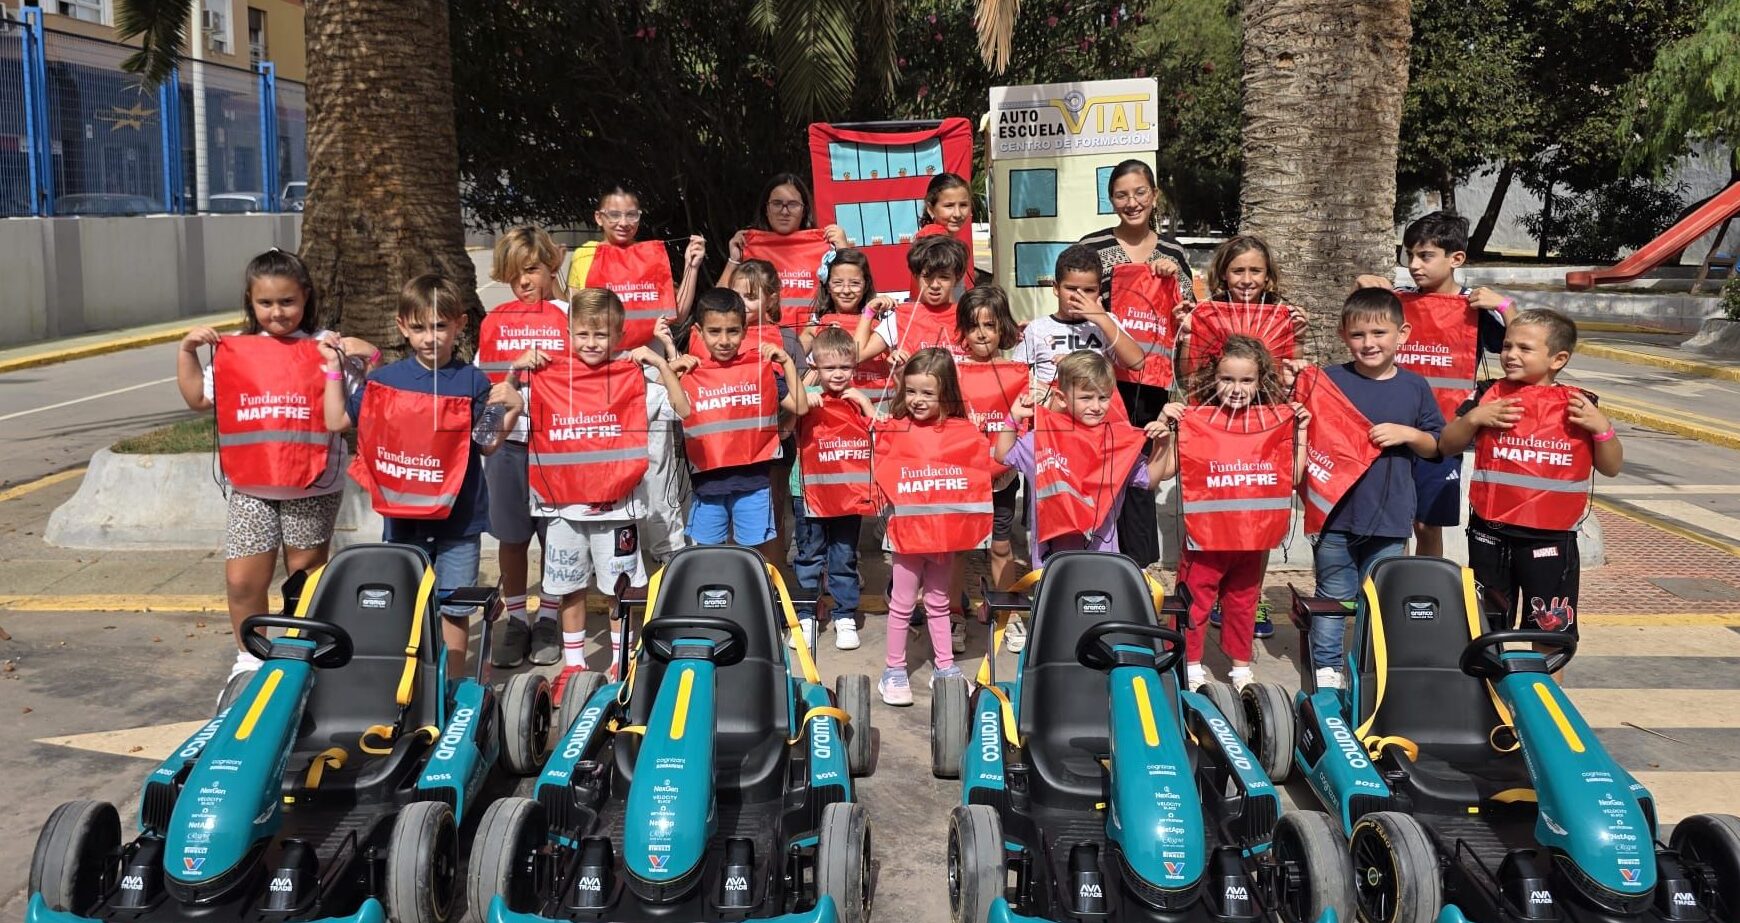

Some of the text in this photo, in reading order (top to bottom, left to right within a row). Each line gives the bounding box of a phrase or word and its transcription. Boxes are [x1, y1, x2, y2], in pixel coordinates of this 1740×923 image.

[999, 110, 1038, 124] AUTO
[999, 122, 1065, 139] ESCUELA
[1000, 133, 1151, 153] CENTRO DE FORMACIÓN
[781, 279, 814, 289] PFRE
[617, 291, 659, 303] APFRE
[499, 325, 561, 337] Fundación
[496, 339, 565, 351] MAPFRE
[1051, 333, 1103, 350] FILA
[1393, 352, 1453, 367] MAPFRE
[697, 382, 757, 398] Fundación
[239, 392, 307, 406] Fundación
[695, 393, 762, 412] MAPFRE
[236, 406, 312, 421] MAPFRE
[551, 411, 618, 427] Fundación
[548, 424, 622, 441] MAPFRE
[817, 437, 870, 450] Fundación
[1498, 431, 1572, 451] Fundación
[376, 446, 442, 468] Fundación
[817, 449, 871, 463] MAPFRE
[1492, 446, 1574, 466] MAPFRE
[374, 459, 445, 483] MAPFRE
[900, 464, 963, 480] Fundación
[1209, 459, 1273, 474] Fundación
[897, 477, 968, 494] MAPFRE
[1206, 473, 1278, 488] MAPFRE
[434, 708, 475, 760] aramco
[562, 707, 601, 759] aramco
[981, 711, 1000, 762] aramco
[1208, 718, 1252, 770] aramco
[1325, 716, 1369, 769] aramco
[426, 773, 452, 781] BOSS
[1355, 780, 1381, 788] BOSS
[122, 876, 144, 884] AVA
[270, 878, 293, 886] AVA
[579, 877, 601, 885] AVA
[725, 877, 747, 885] AVA
[1080, 884, 1102, 892] AVA
[1225, 886, 1248, 894] AVA
